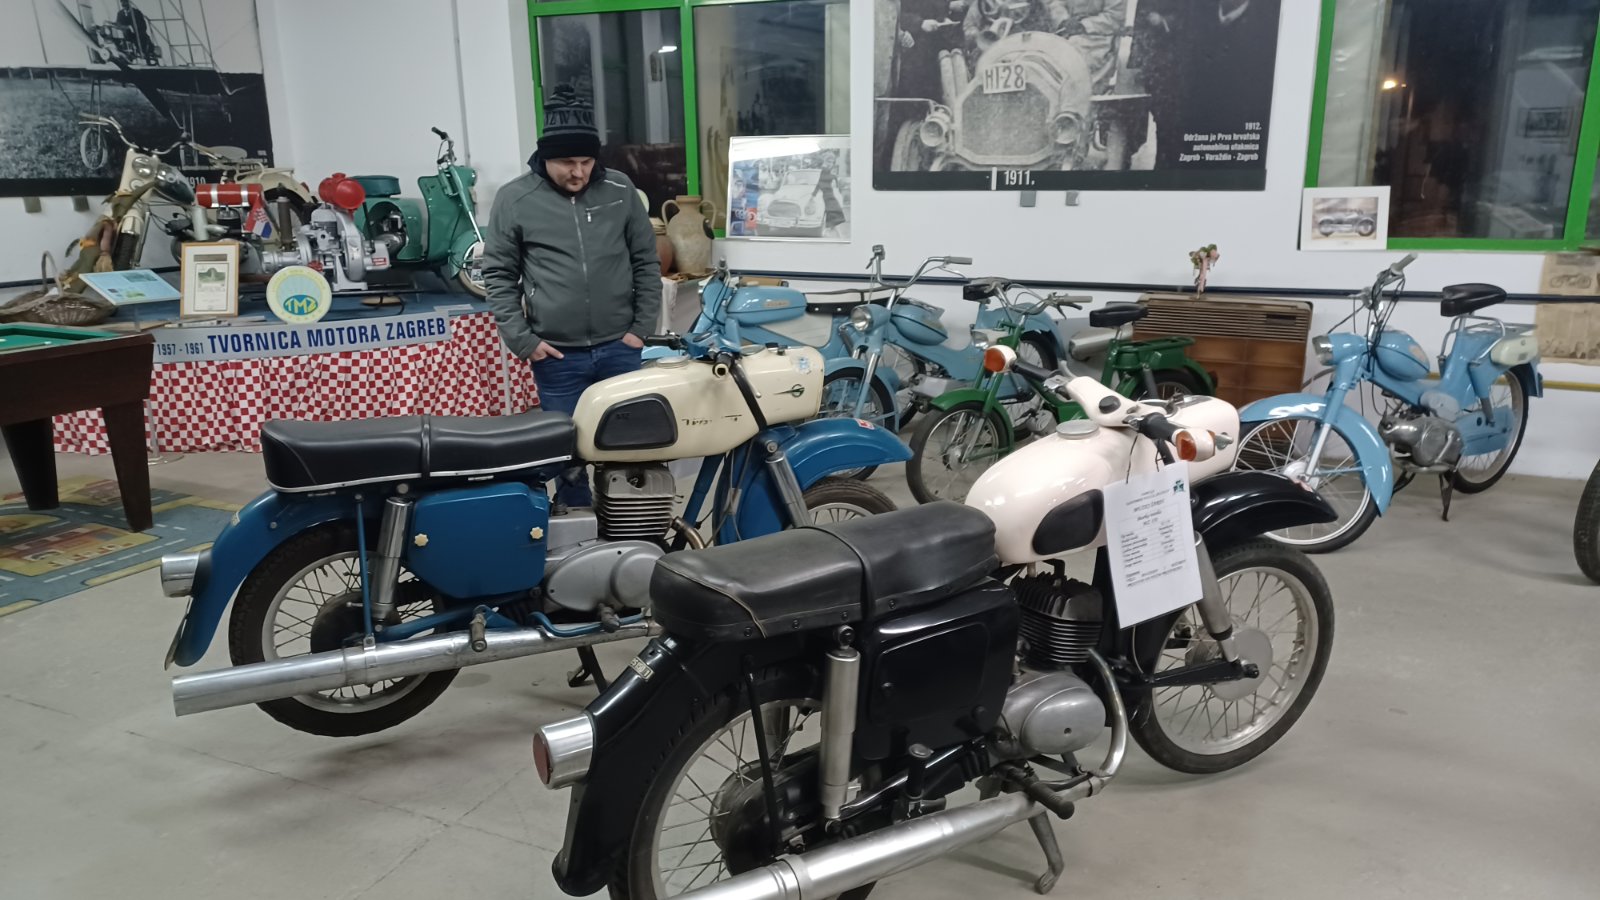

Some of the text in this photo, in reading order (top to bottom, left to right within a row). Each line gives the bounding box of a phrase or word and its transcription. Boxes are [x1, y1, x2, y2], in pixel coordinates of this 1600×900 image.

[1245, 122, 1261, 130] 1912.
[1003, 168, 1036, 186] 1911.
[157, 343, 176, 356] 1957
[184, 342, 204, 355] 1961
[207, 330, 302, 354] TVORNICA
[306, 323, 381, 348] MOTORA
[384, 317, 446, 341] ZAGREB
